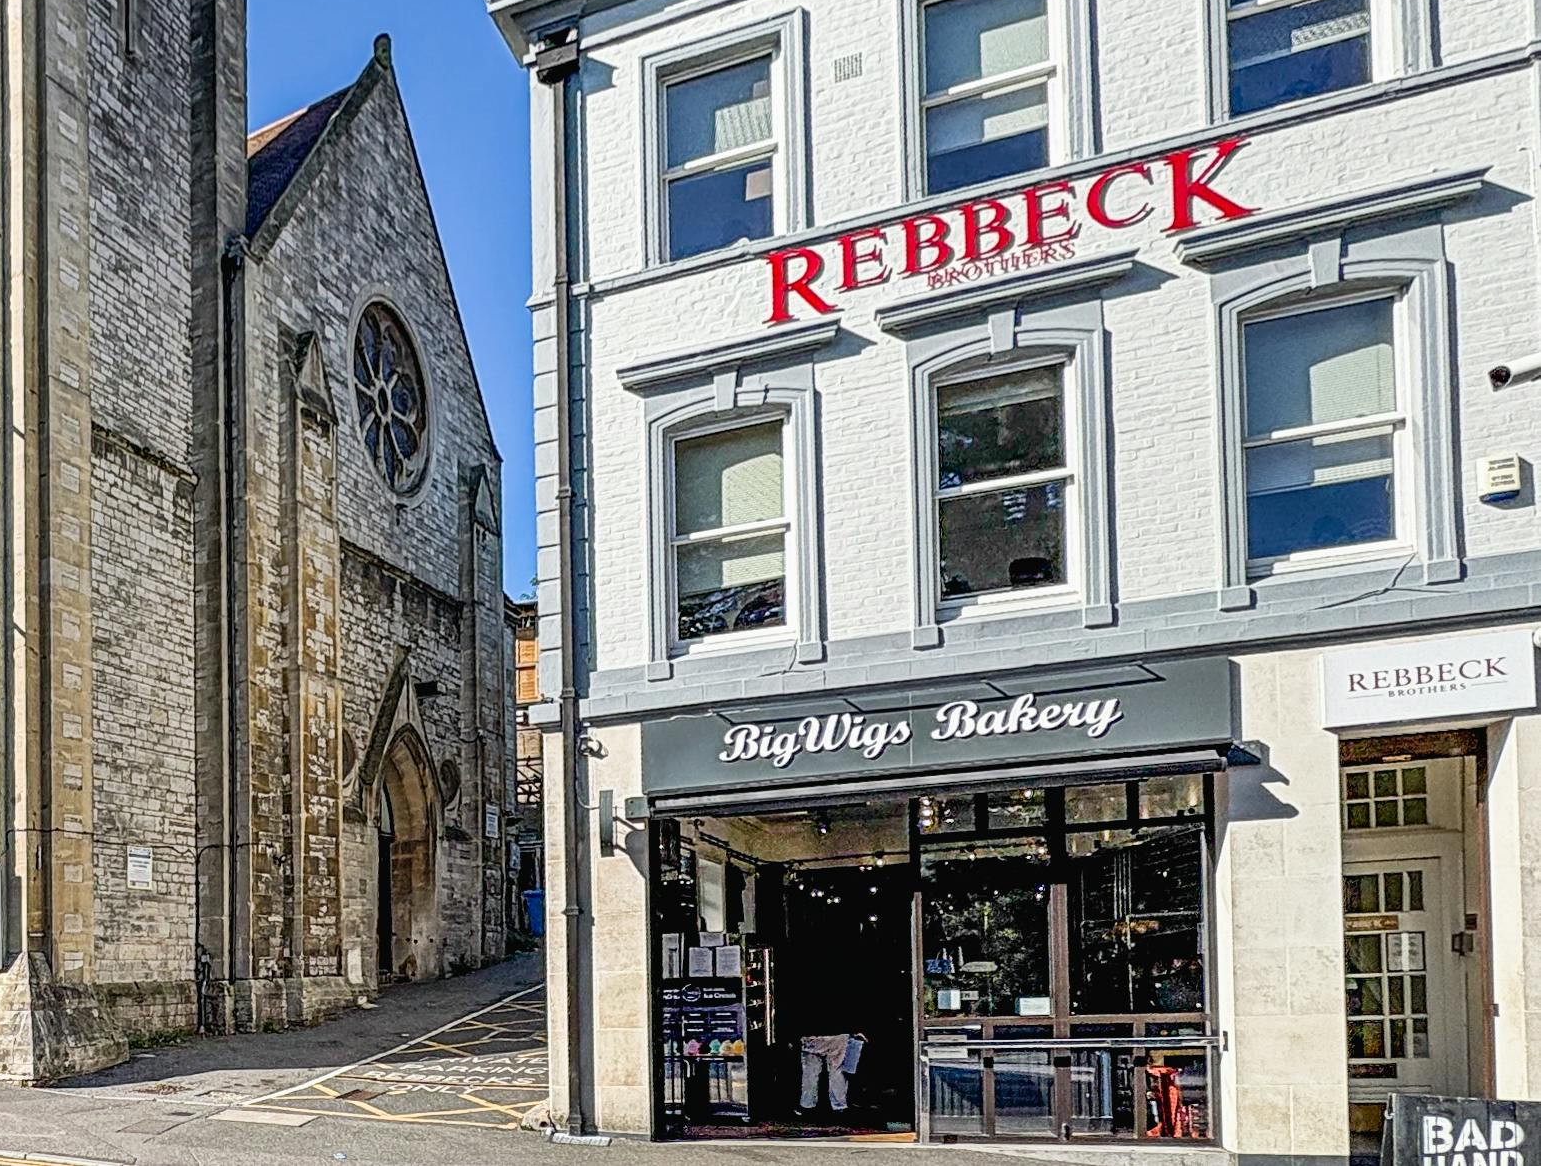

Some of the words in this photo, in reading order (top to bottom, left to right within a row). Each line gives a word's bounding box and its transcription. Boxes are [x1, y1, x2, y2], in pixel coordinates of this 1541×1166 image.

[763, 135, 1265, 325] REBBECK
[927, 241, 1076, 291] BROTHERS
[1347, 656, 1508, 692] REBBECK
[1388, 682, 1467, 698] BROTHERS
[718, 714, 911, 768] BigWigs
[930, 693, 1123, 742] Bakery
[399, 1064, 549, 1075] PARKING
[1422, 1115, 1525, 1154] BAD
